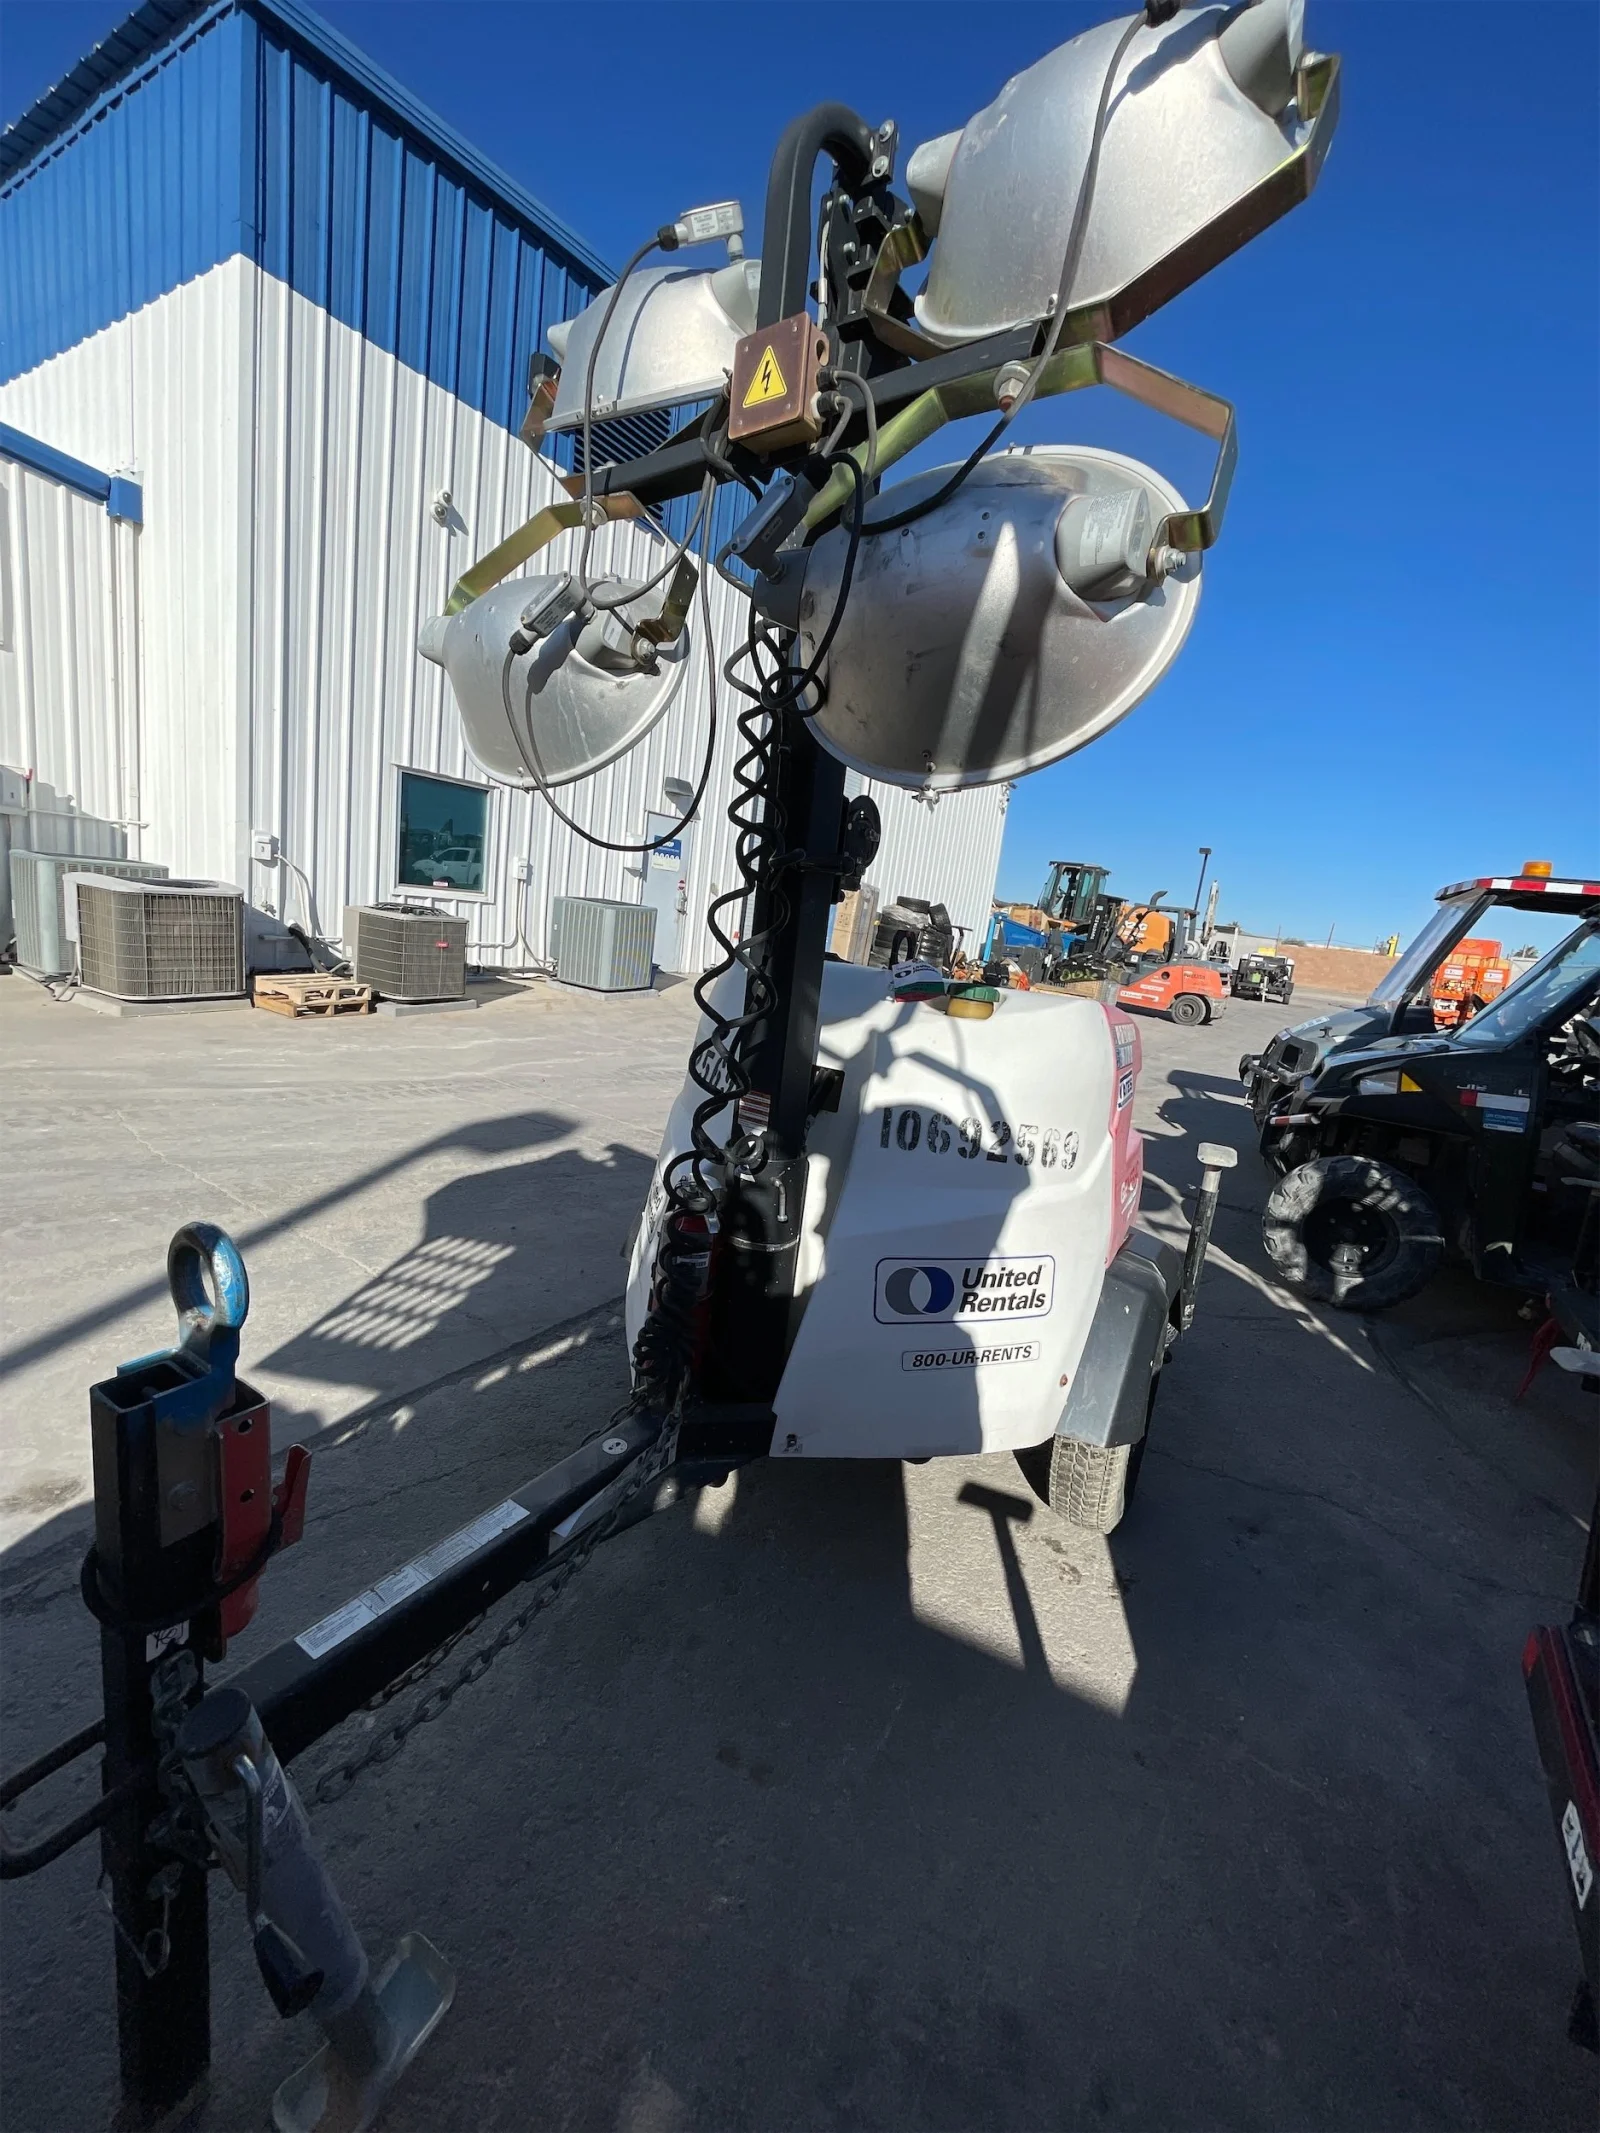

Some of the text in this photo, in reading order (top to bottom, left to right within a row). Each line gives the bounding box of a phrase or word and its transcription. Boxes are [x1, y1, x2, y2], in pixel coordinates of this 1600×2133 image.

[879, 1106, 1080, 1170] 10692569
[962, 1264, 1042, 1289] United
[959, 1289, 1046, 1313] Rentals
[912, 1345, 1032, 1368] 800-UR-RENTS
